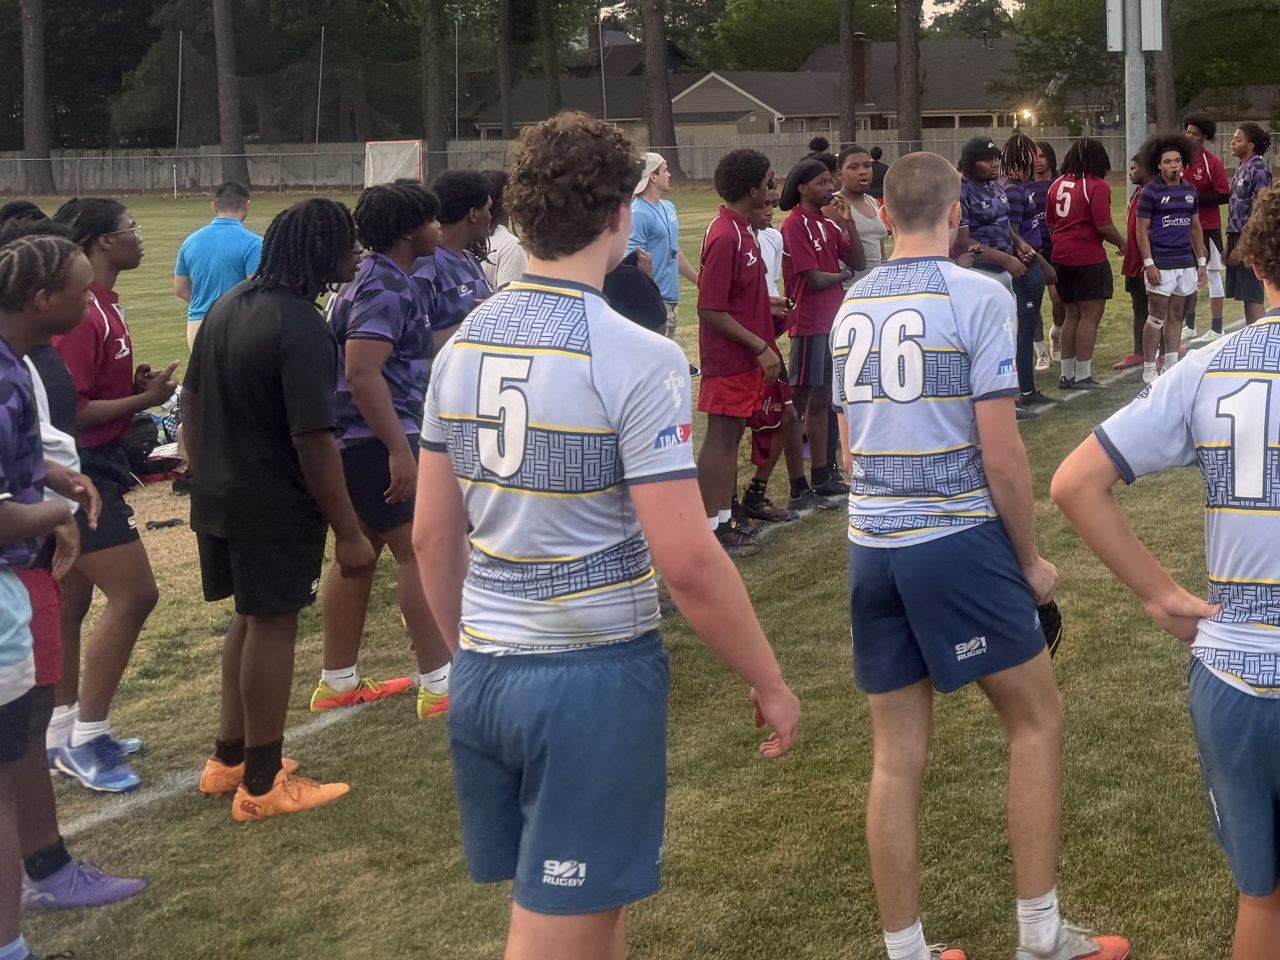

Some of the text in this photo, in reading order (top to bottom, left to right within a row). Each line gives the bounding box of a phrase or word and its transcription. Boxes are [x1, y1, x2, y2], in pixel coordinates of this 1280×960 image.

[1055, 181, 1075, 218] 5
[834, 308, 925, 404] 26
[476, 352, 534, 480] 5
[957, 647, 988, 662] RUGBY
[543, 875, 586, 887] RUGBY
